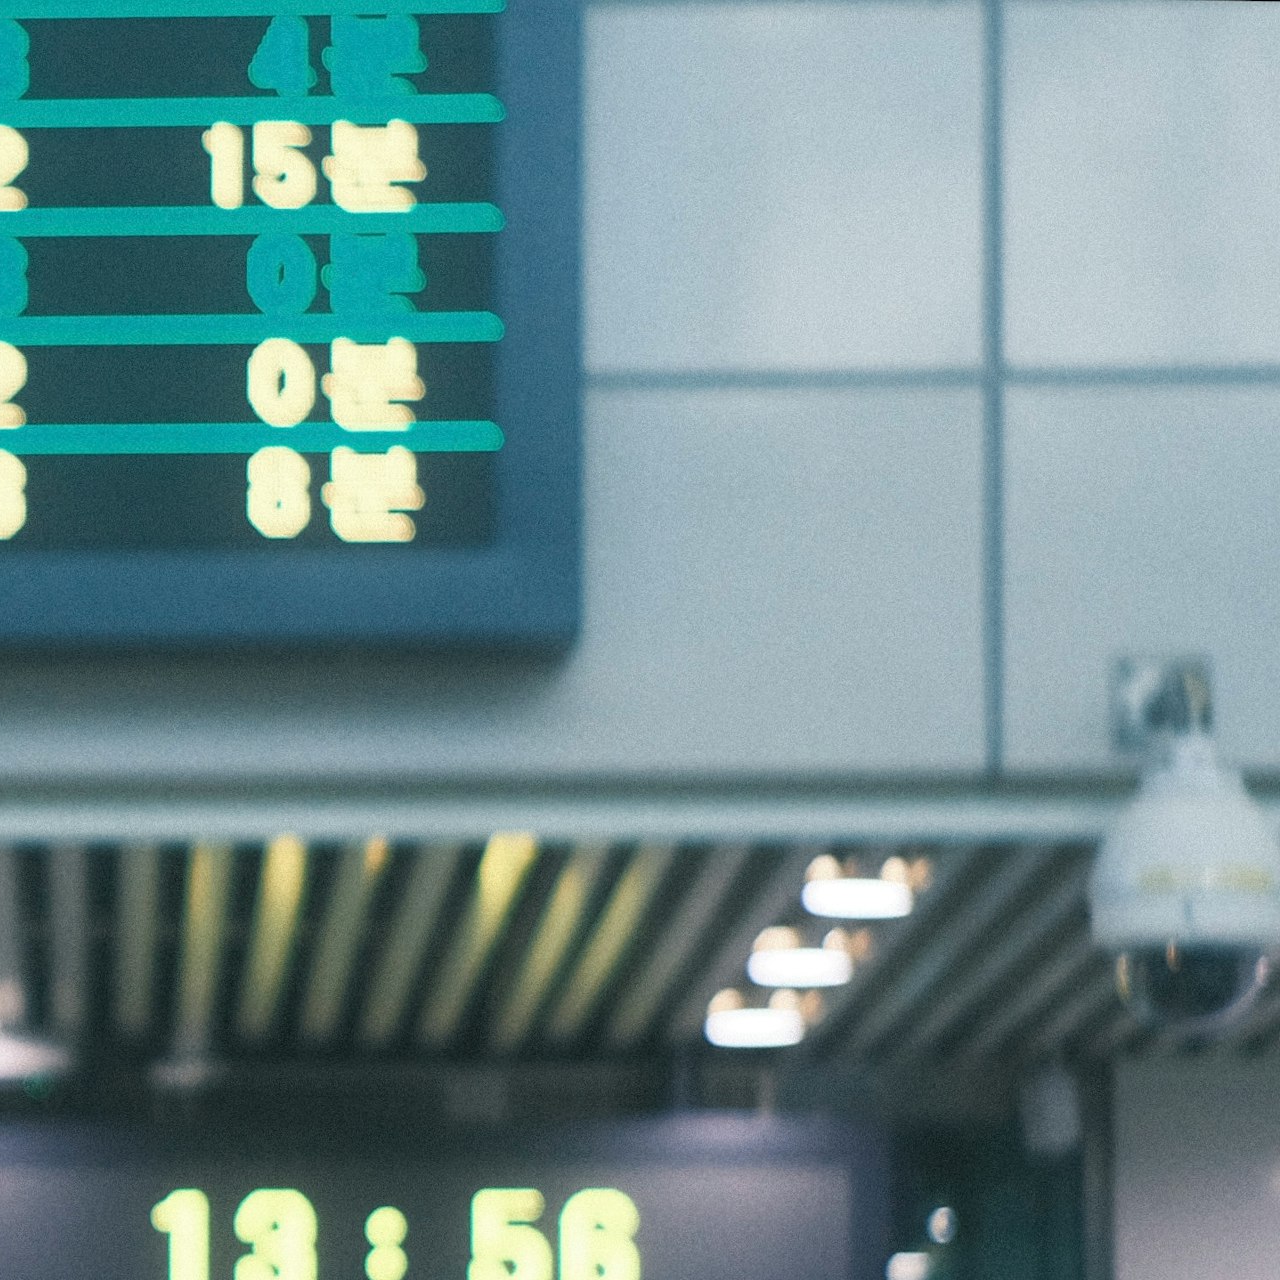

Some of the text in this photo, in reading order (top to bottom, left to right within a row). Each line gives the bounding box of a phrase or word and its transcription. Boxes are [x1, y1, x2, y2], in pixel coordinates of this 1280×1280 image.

[203, 119, 427, 213] 15분
[247, 229, 426, 320] 0분
[247, 337, 425, 431] 0분
